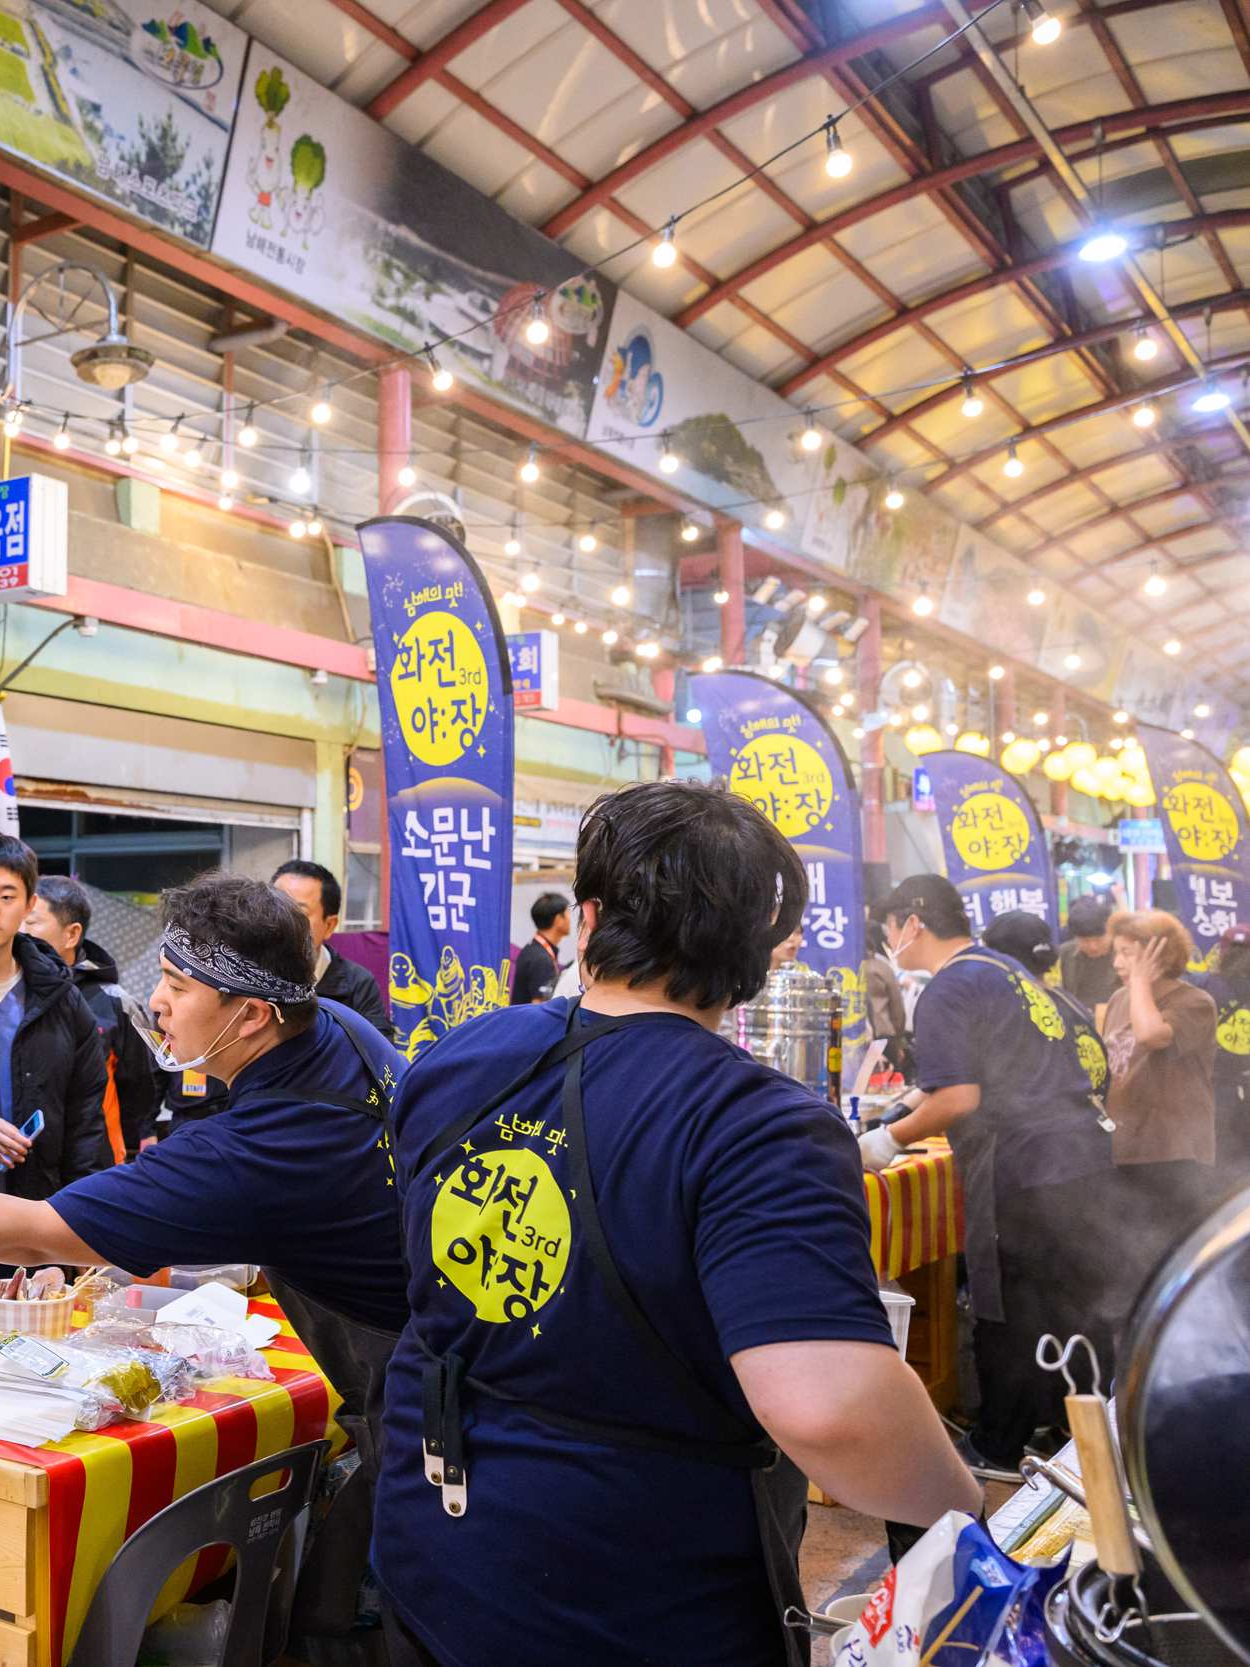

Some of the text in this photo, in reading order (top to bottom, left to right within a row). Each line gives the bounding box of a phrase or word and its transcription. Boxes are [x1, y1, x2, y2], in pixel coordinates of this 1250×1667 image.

[403, 584, 442, 617] 남해의
[398, 630, 482, 688] 화전 3rd
[736, 748, 798, 786] 화전
[958, 803, 1005, 832] 화전
[1168, 792, 1215, 824] 화전
[402, 807, 496, 870] 소문난
[419, 871, 477, 932] 김군
[800, 906, 849, 950] 장
[494, 1113, 568, 1156] 남해 맛
[520, 1225, 562, 1258] 3rd
[447, 1234, 550, 1321] 야장
